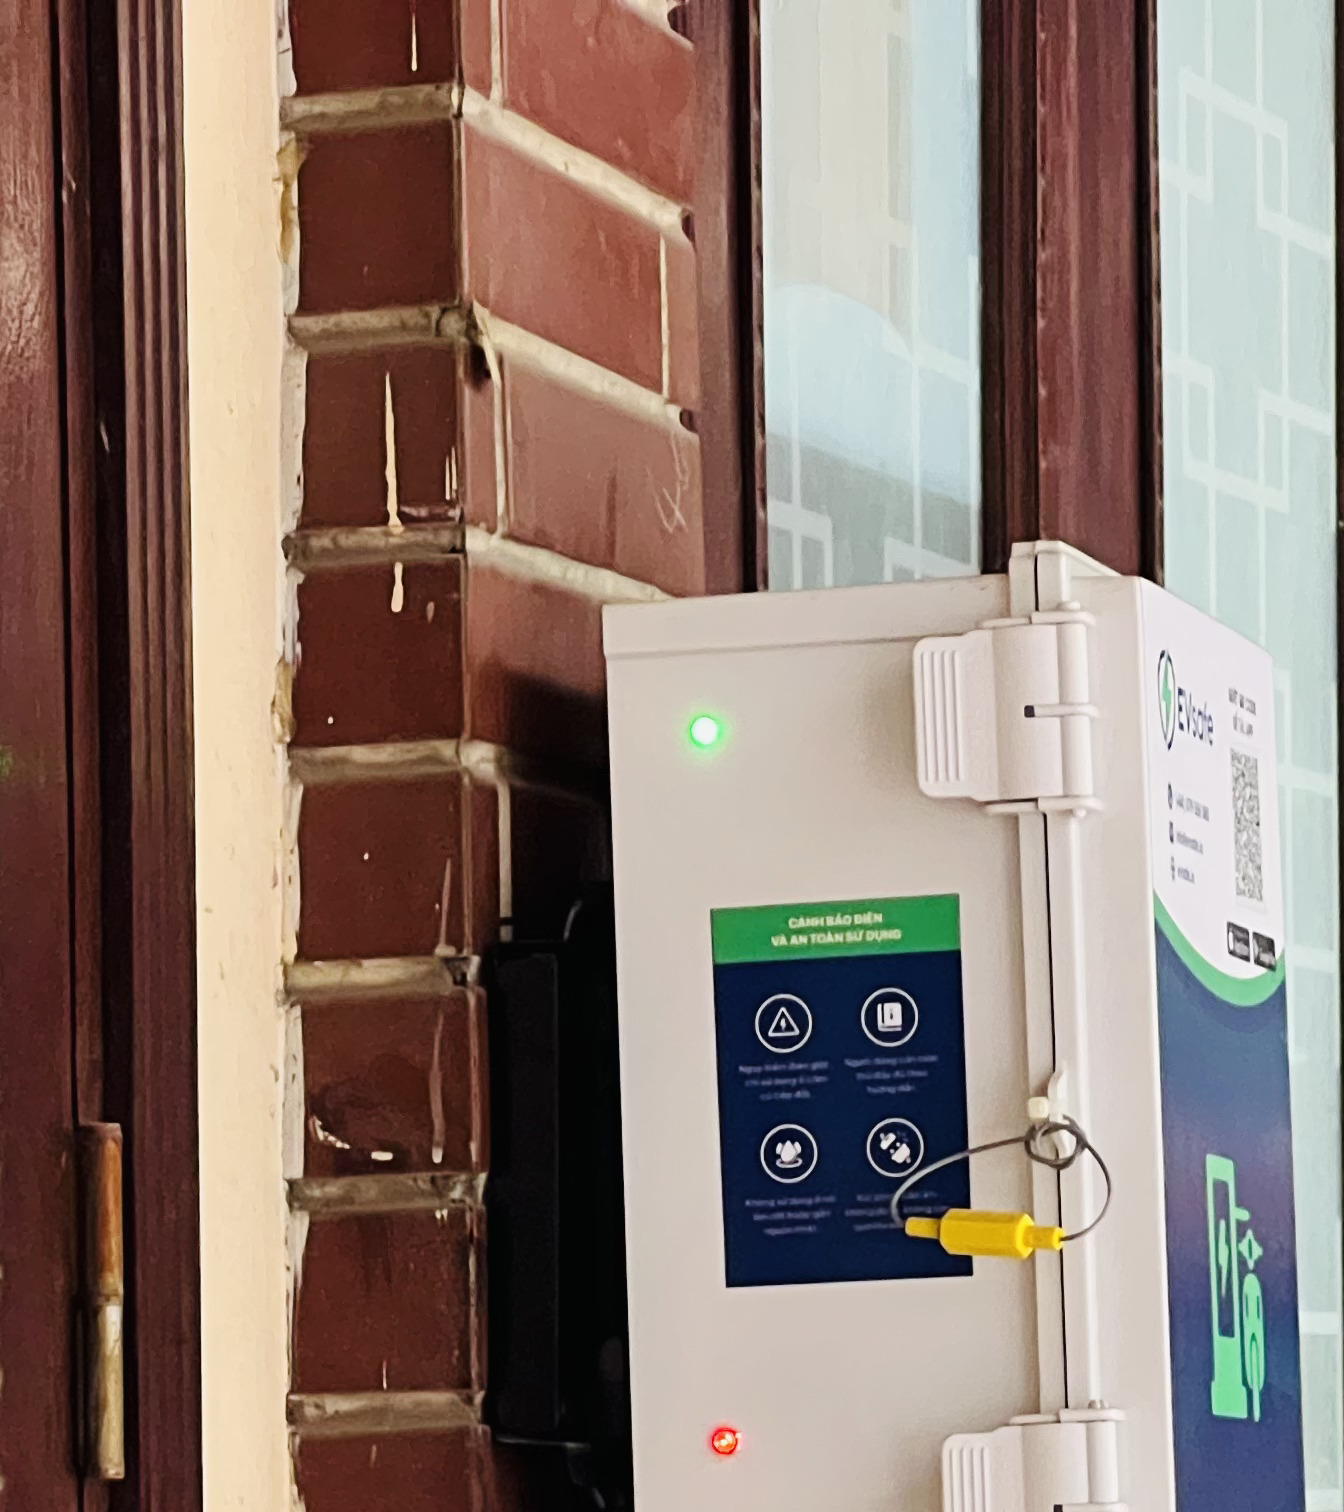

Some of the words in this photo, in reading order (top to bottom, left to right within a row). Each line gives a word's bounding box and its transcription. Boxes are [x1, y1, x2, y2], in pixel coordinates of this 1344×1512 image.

[1177, 685, 1214, 747] EVsafe
[788, 913, 824, 928] CẢNH
[825, 911, 852, 926] BÁO
[853, 911, 882, 926] ĐIỆN
[770, 933, 787, 947] VÀ
[789, 934, 807, 946] AN
[809, 928, 844, 945] TOÀN
[845, 927, 864, 942] SỬ
[864, 928, 902, 944] DỤNG
